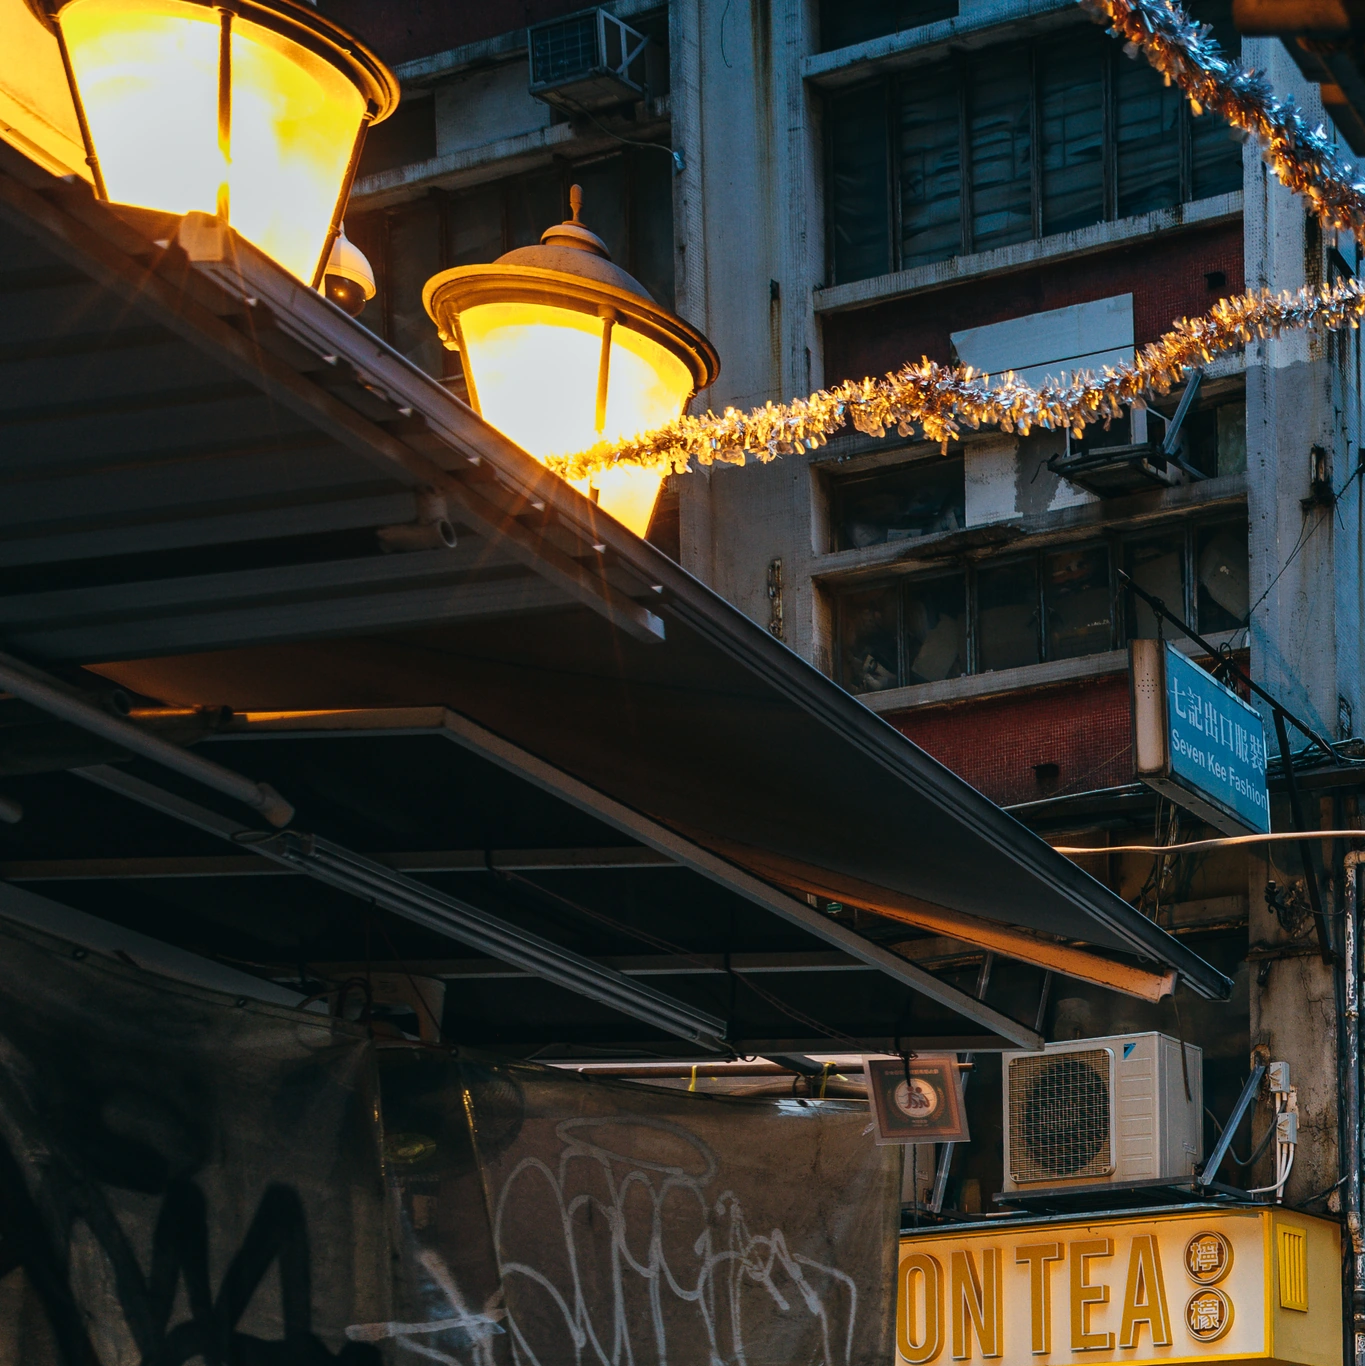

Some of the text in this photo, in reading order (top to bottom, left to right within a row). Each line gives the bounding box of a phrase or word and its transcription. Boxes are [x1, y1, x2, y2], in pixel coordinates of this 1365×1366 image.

[1171, 677, 1264, 775] 七記出口服裝
[1172, 729, 1267, 811] Seven Kee Fashion
[1015, 1234, 1173, 1354] TEA
